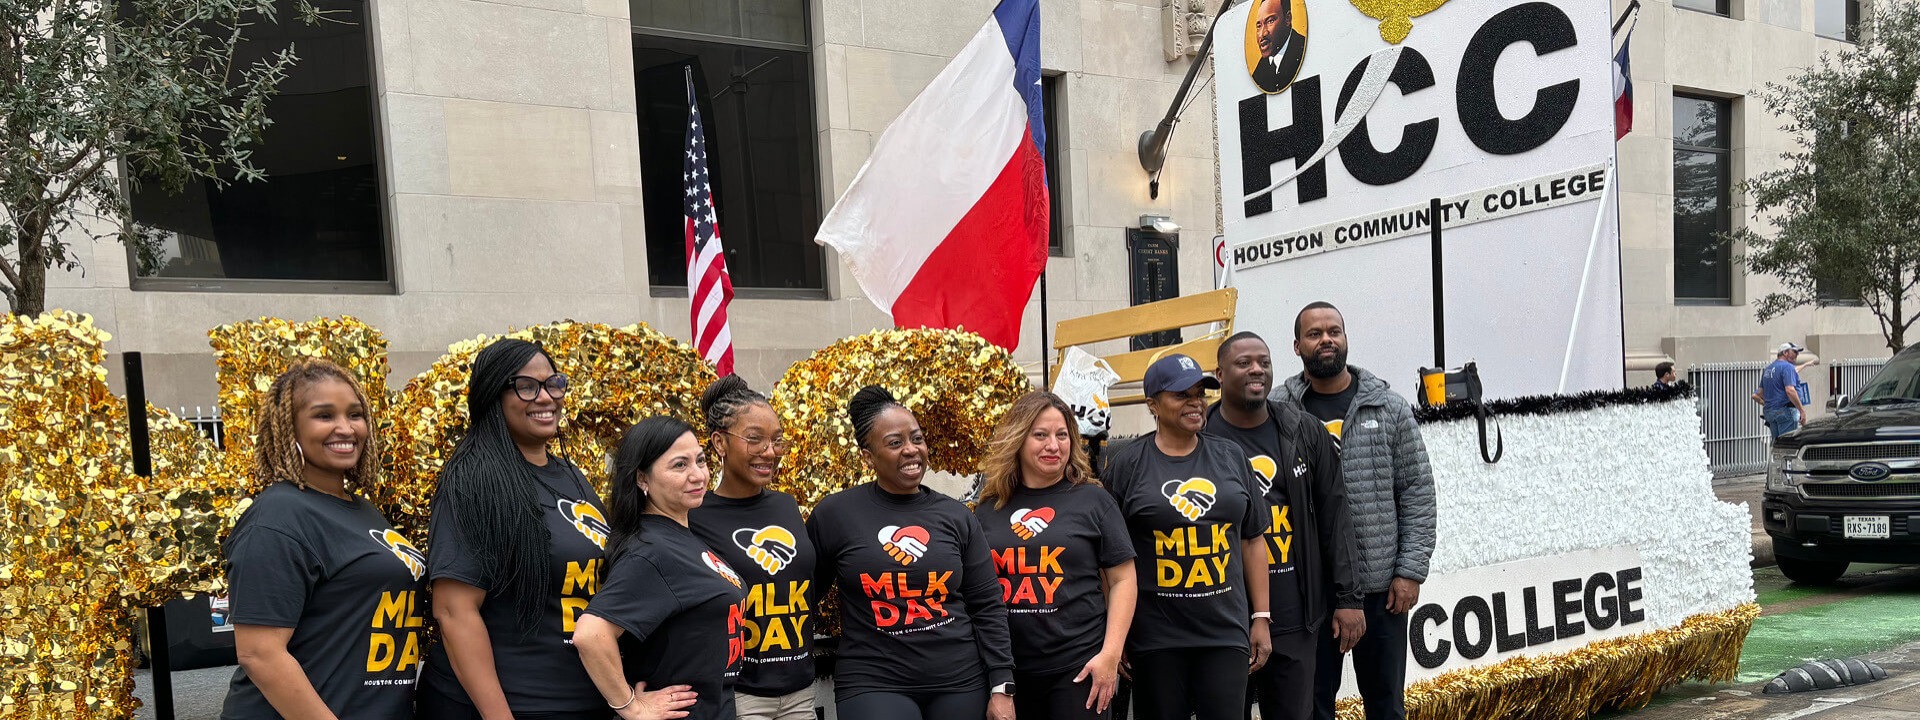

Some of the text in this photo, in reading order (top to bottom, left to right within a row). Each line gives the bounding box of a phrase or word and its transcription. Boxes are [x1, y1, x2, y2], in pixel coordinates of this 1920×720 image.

[1239, 1, 1580, 218] HCC
[1233, 169, 1605, 265] HOUSTON COMMUNTY COLLEGE
[1293, 463, 1307, 478] HC
[1858, 467, 1878, 477] Ford
[1153, 523, 1233, 557] MLK
[990, 545, 1066, 575] MLK
[1156, 552, 1231, 589] DAY
[860, 570, 954, 600] MLK
[372, 590, 423, 628] ML
[870, 593, 949, 627] DAY
[1408, 566, 1645, 669] COLLEGE
[366, 631, 419, 672] DA
[760, 656, 792, 664] COMMUNITY
